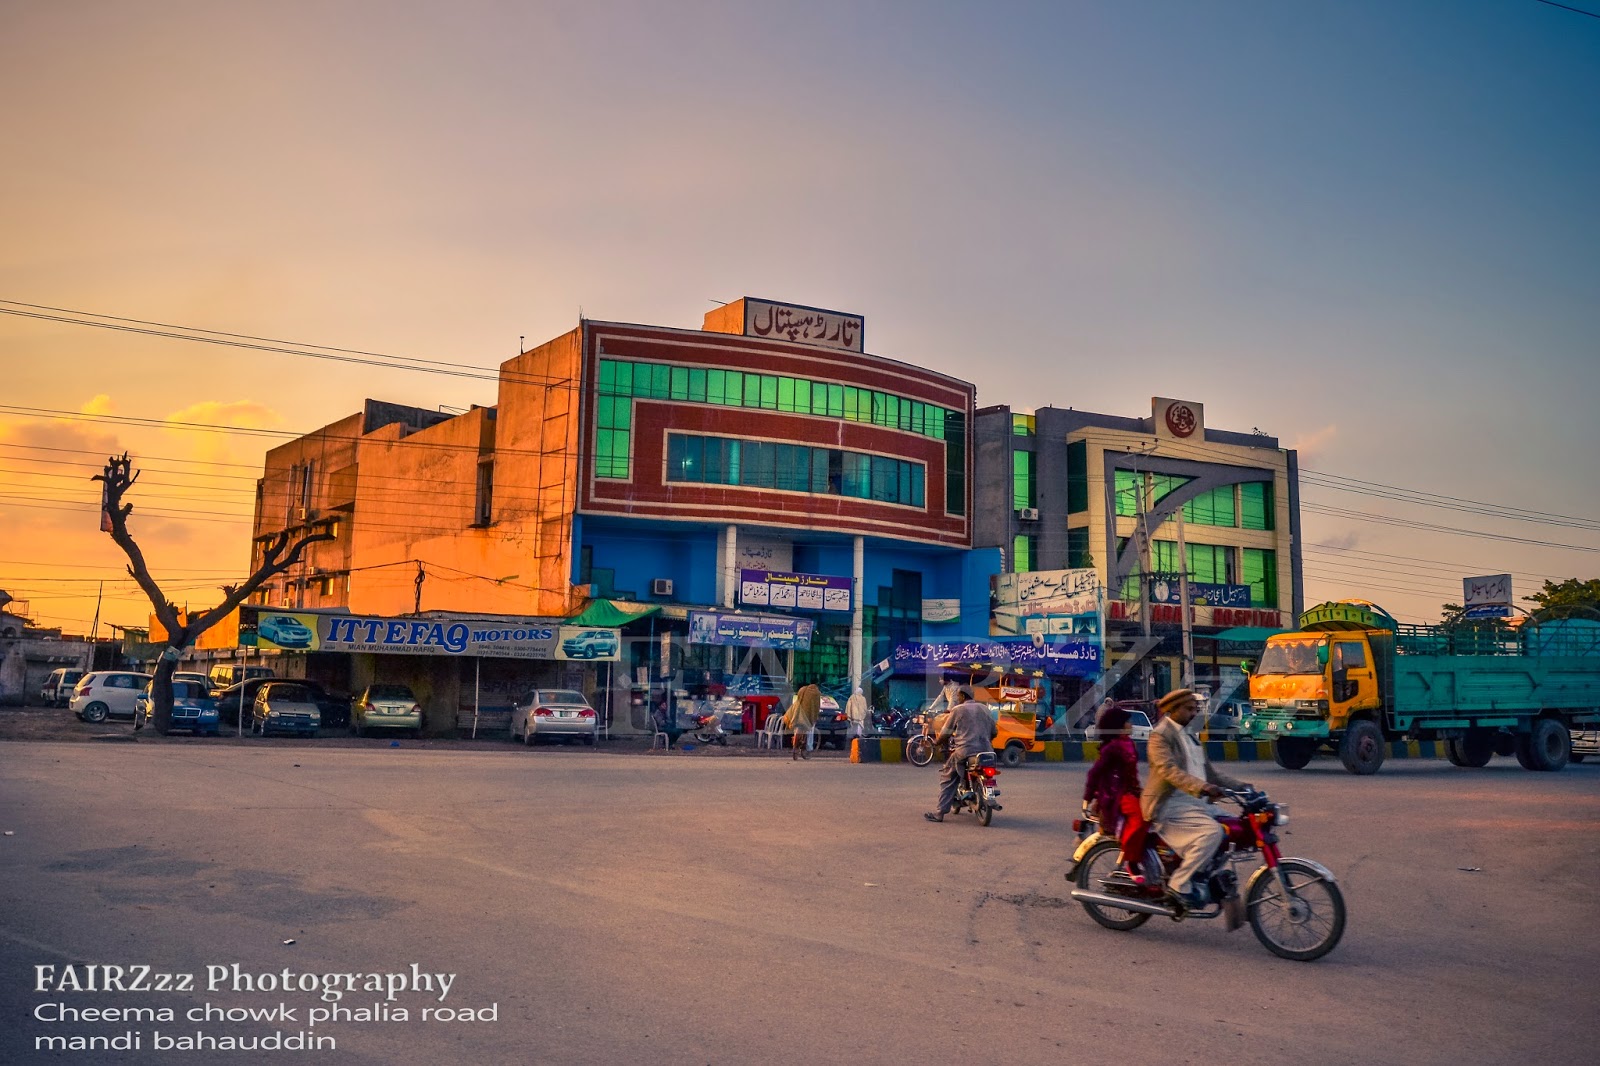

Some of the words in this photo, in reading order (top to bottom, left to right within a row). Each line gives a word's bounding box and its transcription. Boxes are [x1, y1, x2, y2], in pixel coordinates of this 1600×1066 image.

[1212, 608, 1283, 629] HOSPITAL
[326, 617, 472, 655] ITTEFAQ
[473, 629, 553, 644] MOTORS
[367, 645, 412, 653] MUHAMMAD
[412, 646, 436, 654] RAFIQ
